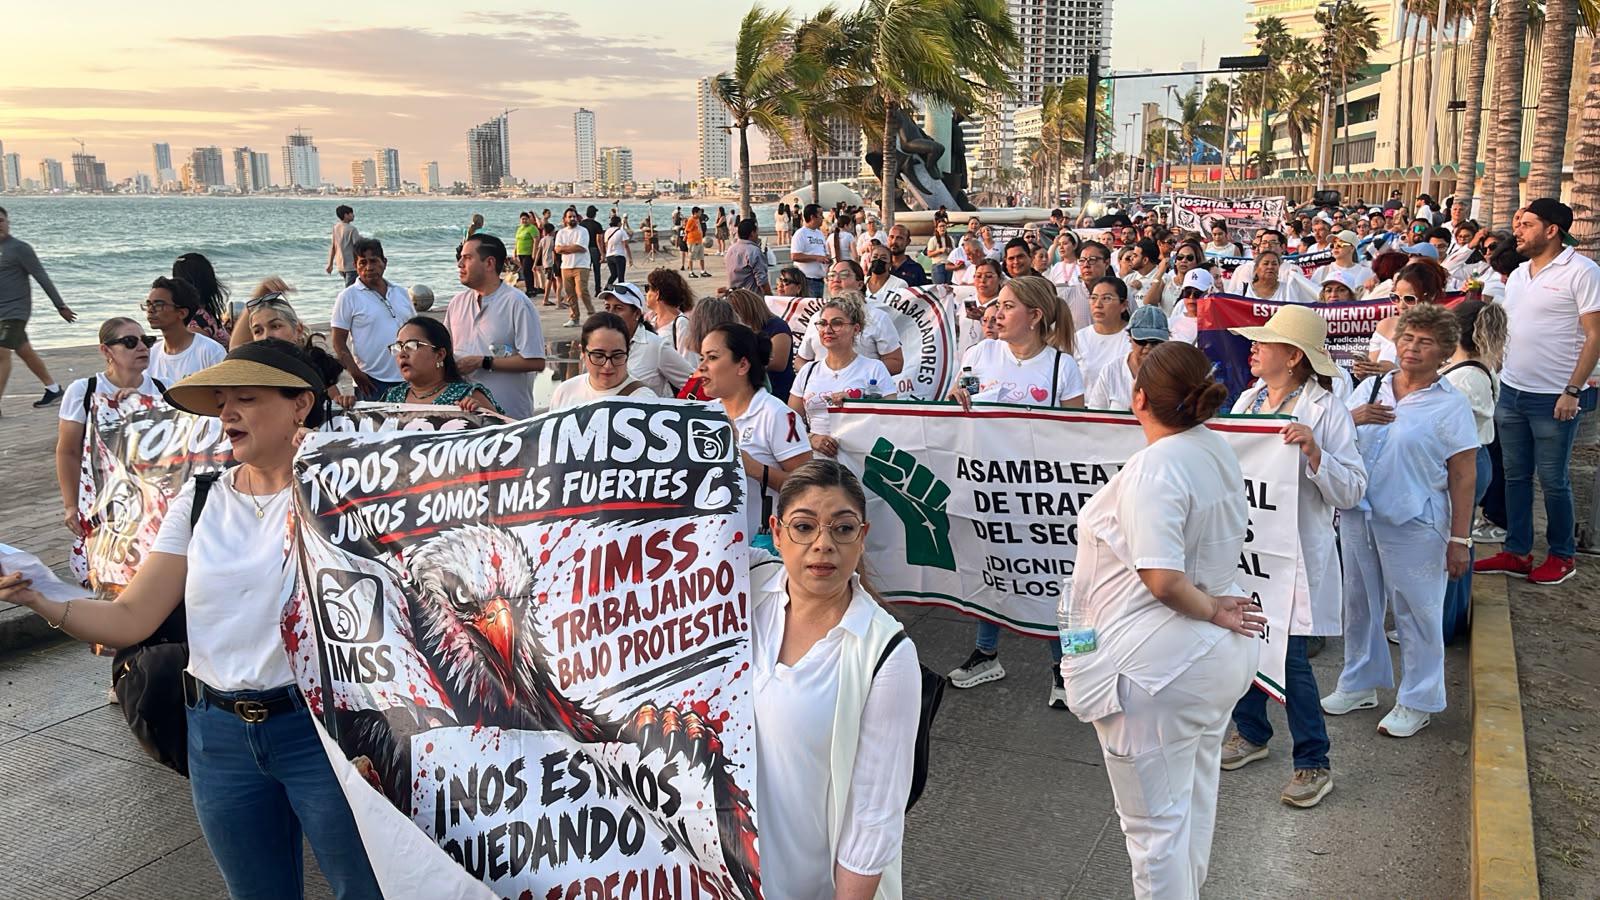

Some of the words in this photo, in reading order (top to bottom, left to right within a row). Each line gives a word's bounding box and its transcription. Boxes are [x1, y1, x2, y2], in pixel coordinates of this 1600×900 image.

[1176, 197, 1230, 208] HOSPITAL
[1253, 303, 1280, 317] EST
[1312, 306, 1376, 321] VIMIENTO
[1378, 305, 1400, 319] TIE
[883, 290, 937, 386] TRABAJADORES
[301, 444, 402, 515] TODOS
[409, 426, 528, 484] SOMOS
[538, 407, 682, 467] IMSS
[956, 457, 1110, 485] ASAMBLEA
[416, 485, 490, 527] SOMOS
[497, 465, 551, 515] MÁS
[562, 467, 688, 506] FUERTES
[973, 490, 1010, 514] DE
[971, 519, 1023, 544] DEL
[572, 522, 700, 604] ¡IMSS
[982, 570, 1008, 593] DE
[1012, 579, 1061, 597] LOS
[985, 555, 1076, 576] ¡DIGNID
[552, 560, 735, 654] TRABAJANDO
[557, 641, 612, 691] BAJO
[617, 592, 748, 673] PROTESTA!
[327, 642, 396, 684] IMSS
[435, 756, 528, 845] ¡NOS
